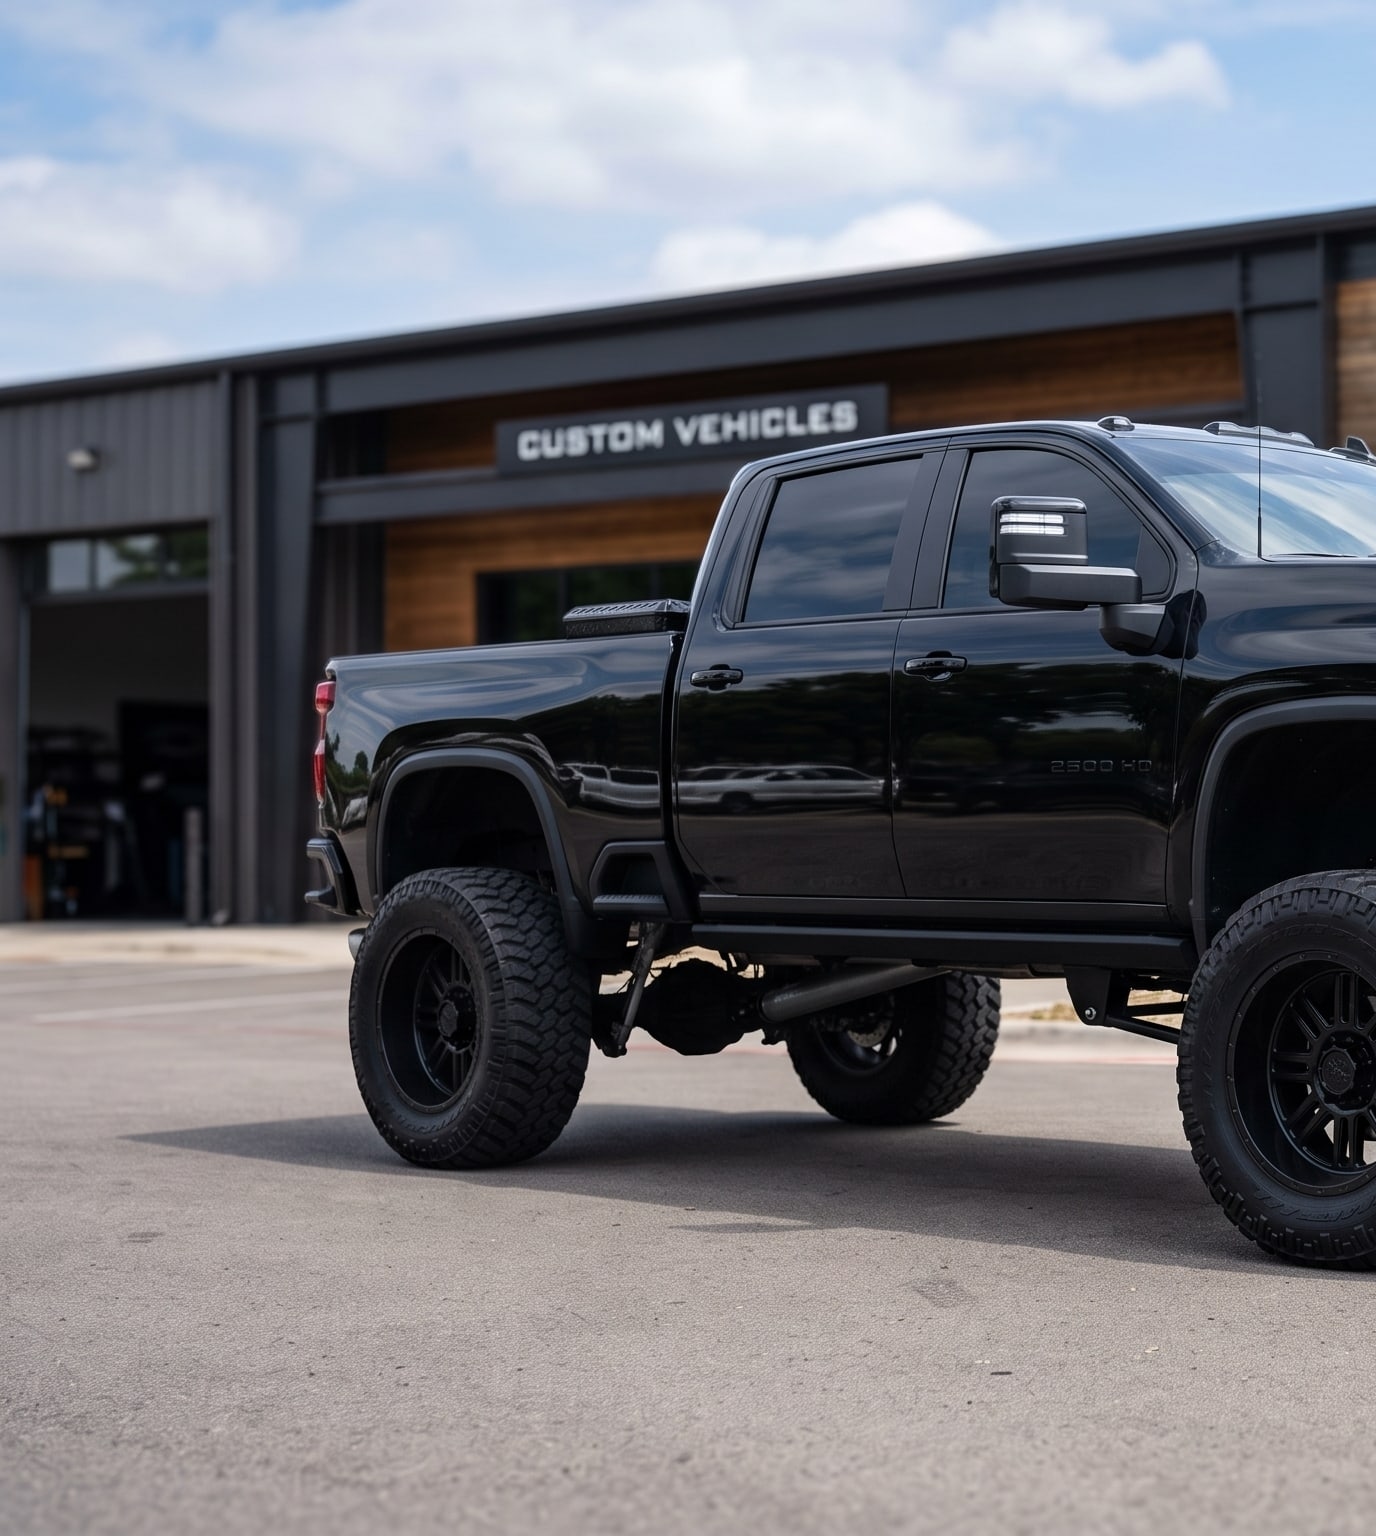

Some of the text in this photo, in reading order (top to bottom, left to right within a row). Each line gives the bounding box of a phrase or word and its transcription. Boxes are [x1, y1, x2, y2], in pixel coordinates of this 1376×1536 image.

[518, 401, 858, 461] CUSTOM VEHICLES
[1051, 760, 1152, 773] 2500 HD
